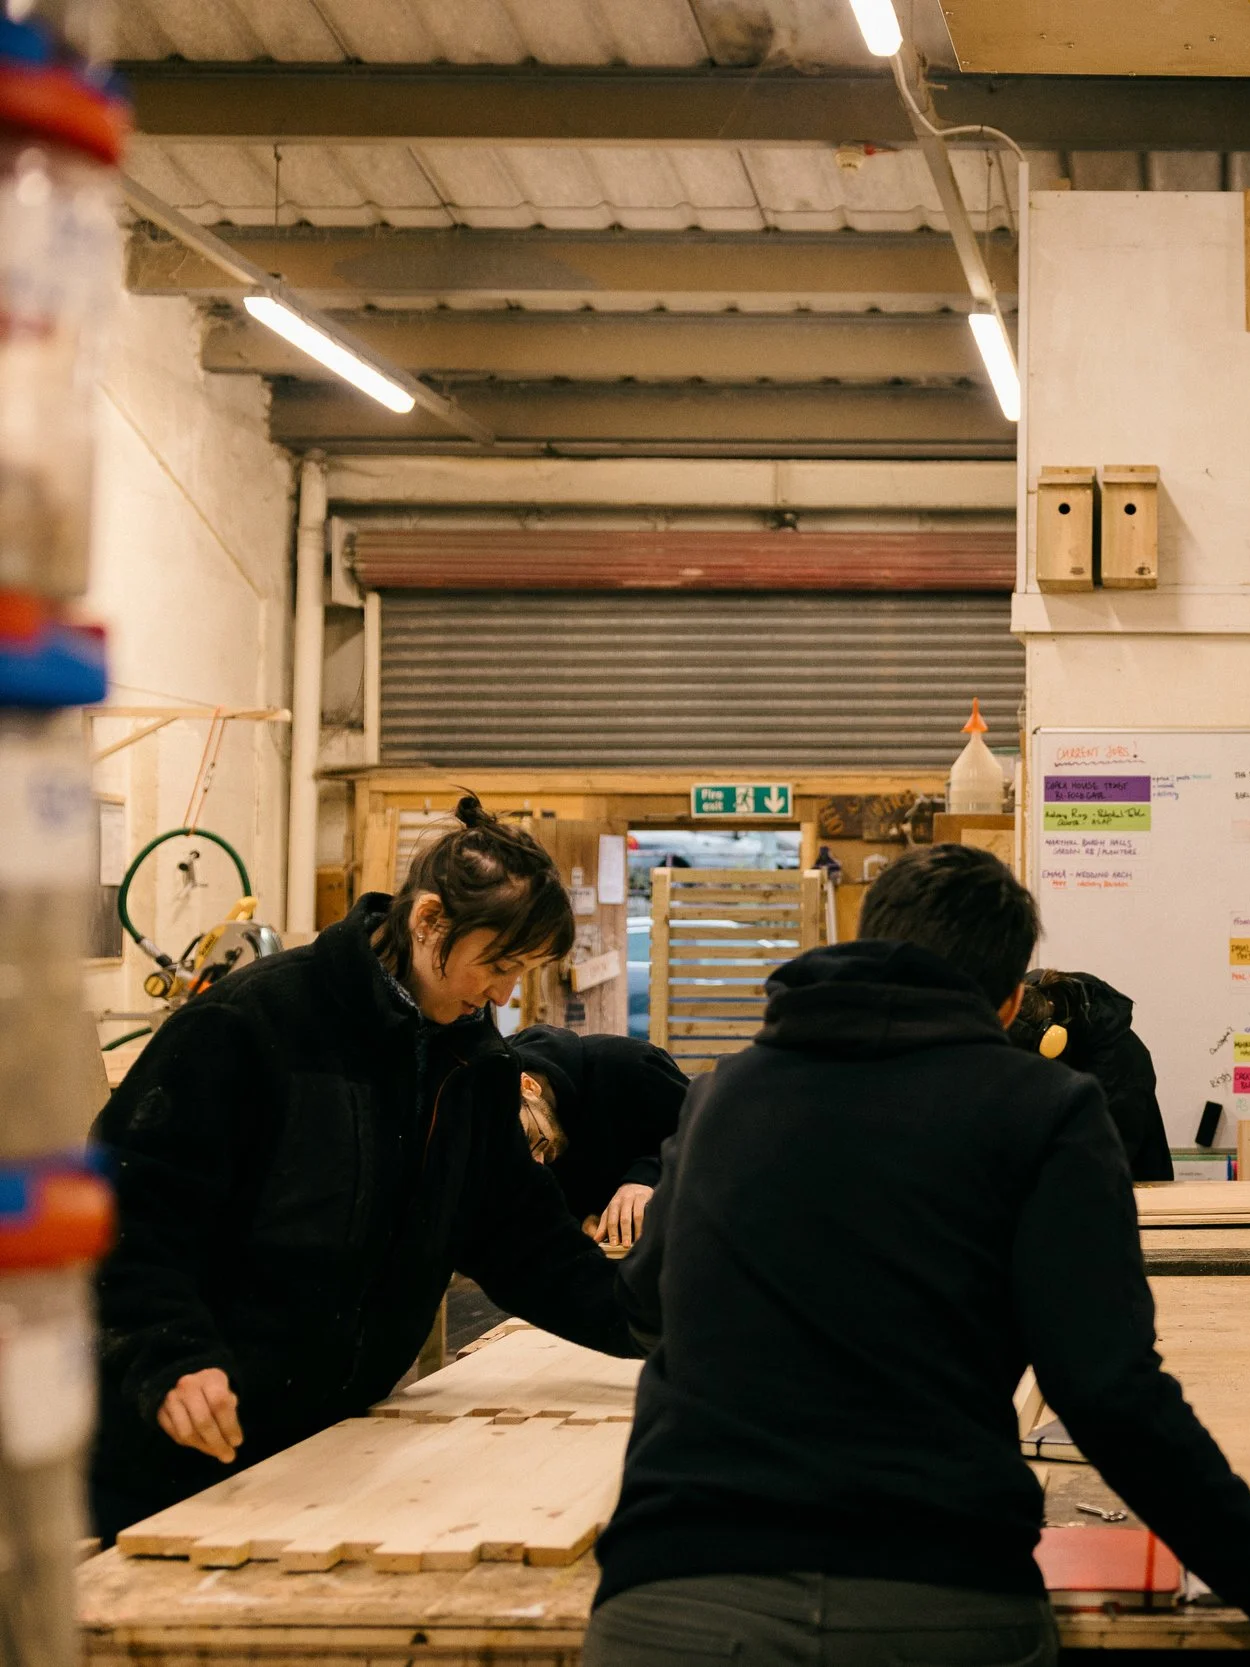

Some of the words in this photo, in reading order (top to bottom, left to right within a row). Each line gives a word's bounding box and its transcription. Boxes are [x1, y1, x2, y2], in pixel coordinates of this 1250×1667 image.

[1056, 745, 1099, 760] CURRENT
[701, 789, 724, 800] Fire
[702, 801, 723, 812] exit
